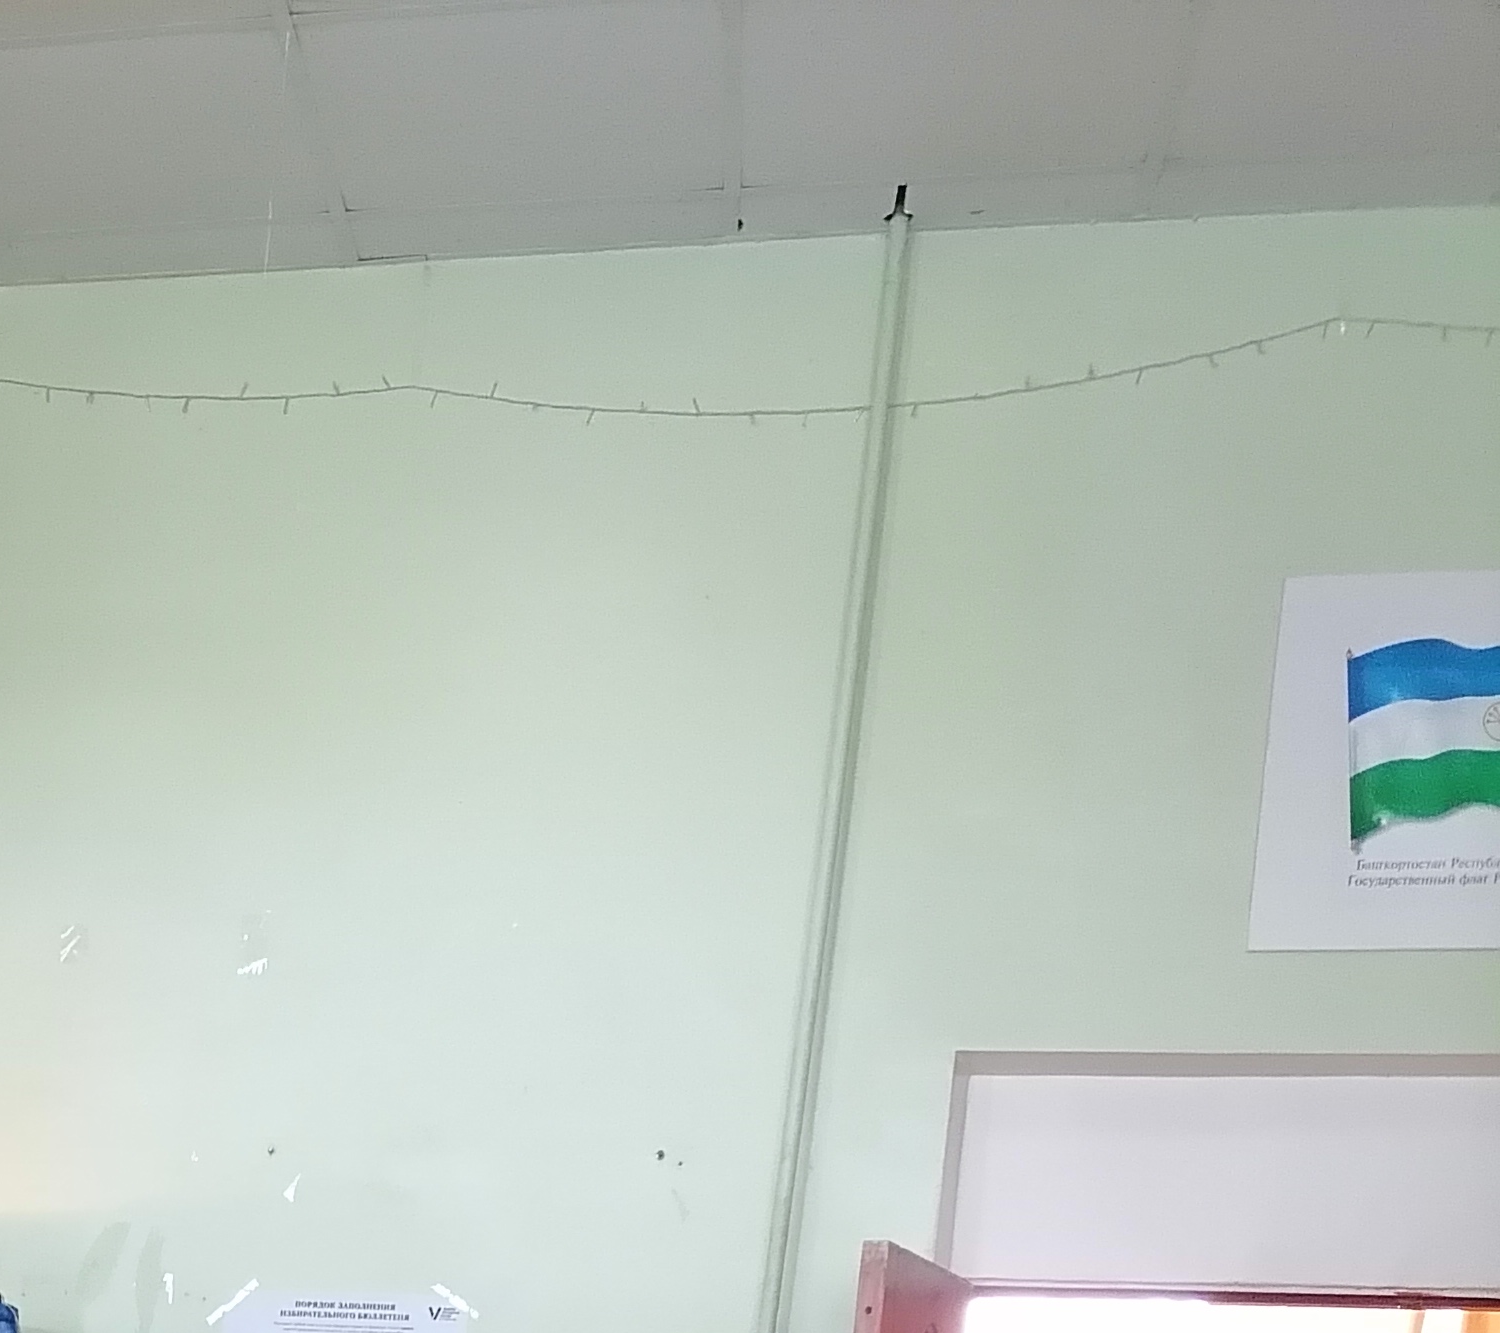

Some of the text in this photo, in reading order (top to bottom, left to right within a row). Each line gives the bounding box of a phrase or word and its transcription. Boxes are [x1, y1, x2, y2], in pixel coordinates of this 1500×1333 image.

[1348, 872, 1455, 889] Государственный
[1459, 874, 1488, 887] флаг
[295, 1300, 396, 1311] ПОРЯДОК ЗАПОЛНЕНИЯ
[280, 1309, 410, 1321] ИЗБИРАТЕЛЬНОГО БЮЛЛЕТЕНЯ
